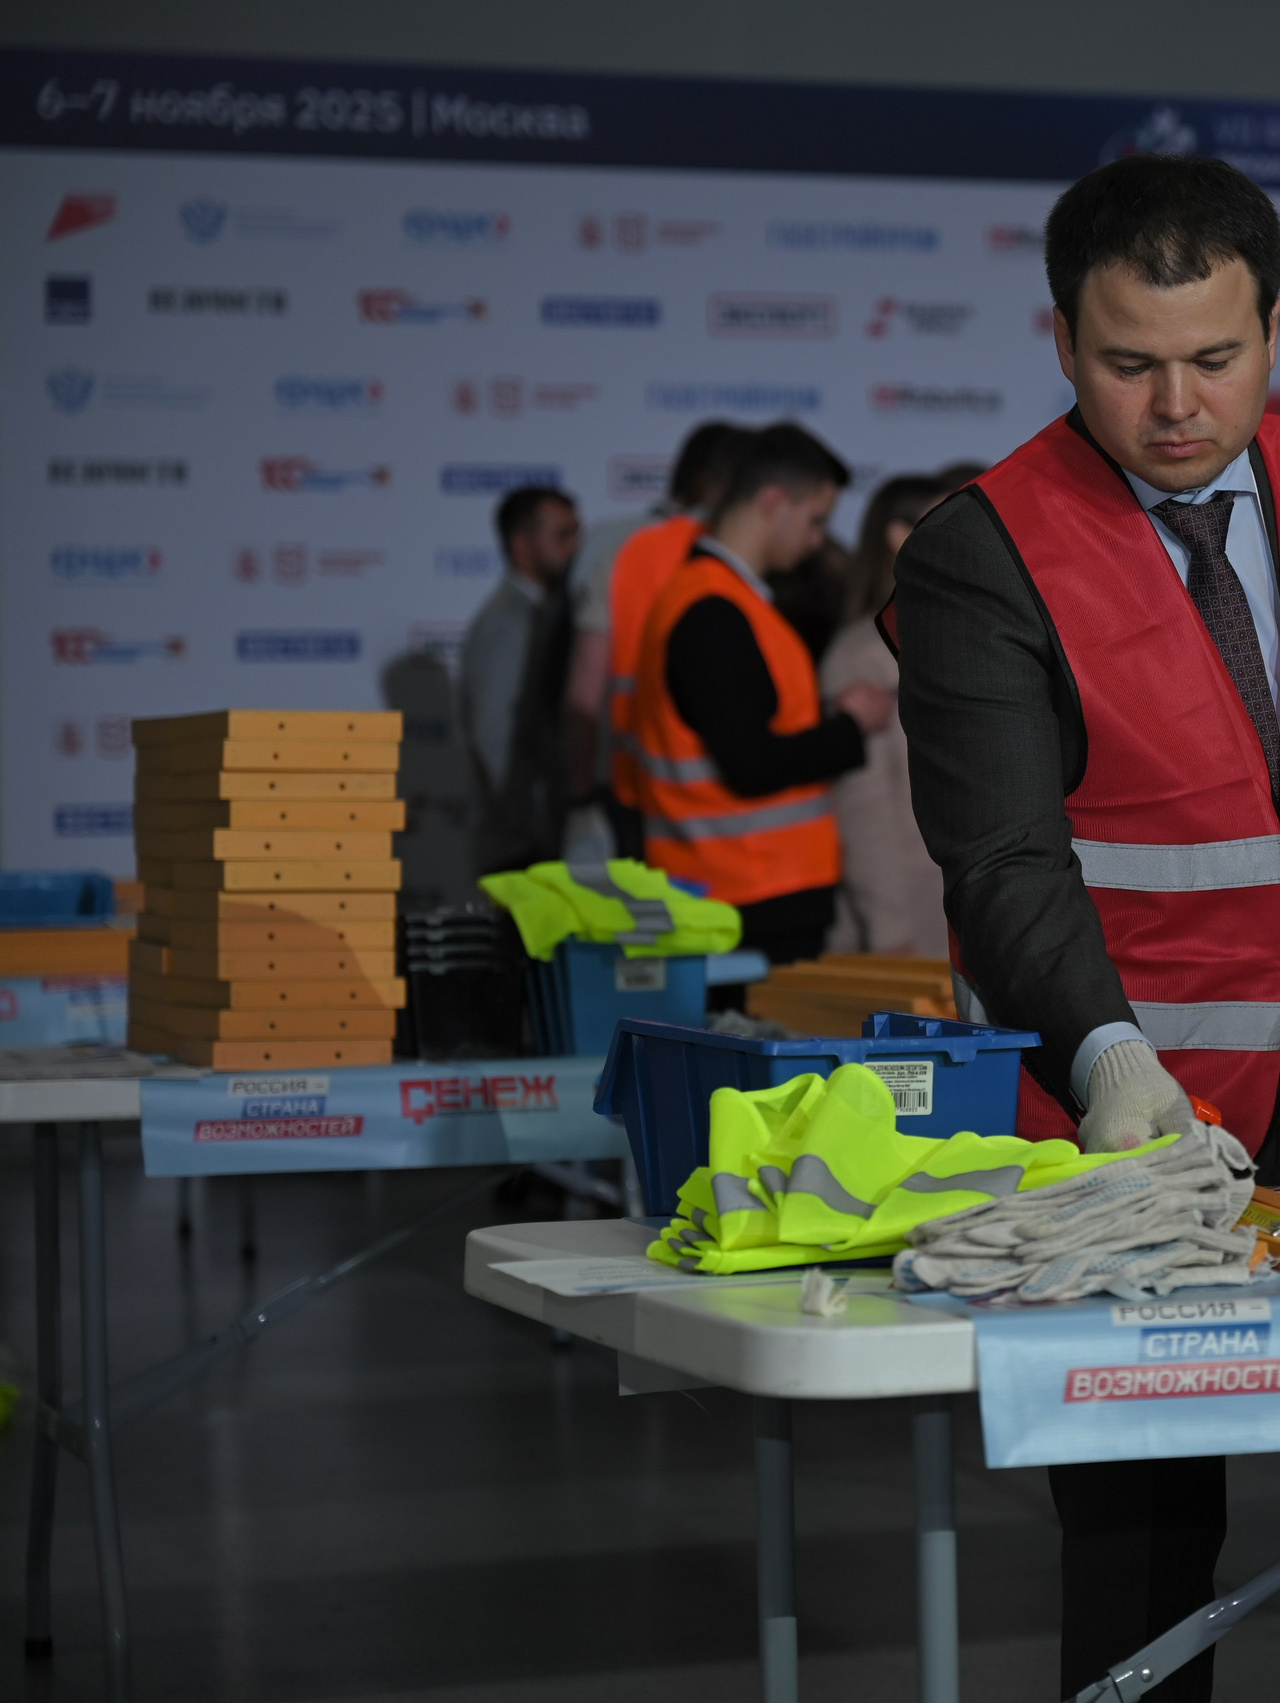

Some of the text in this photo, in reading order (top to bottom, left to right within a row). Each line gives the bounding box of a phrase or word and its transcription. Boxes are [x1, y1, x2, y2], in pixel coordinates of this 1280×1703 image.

[128, 83, 288, 136] ноября
[294, 85, 404, 134] 2025
[430, 91, 592, 142] Москва
[232, 1079, 307, 1096] РОССИЯ
[246, 1098, 320, 1117] СТРАНА
[198, 1117, 356, 1140] ВОЗМОЖНОСТЕЙ
[1144, 1329, 1261, 1359] СТРАНА
